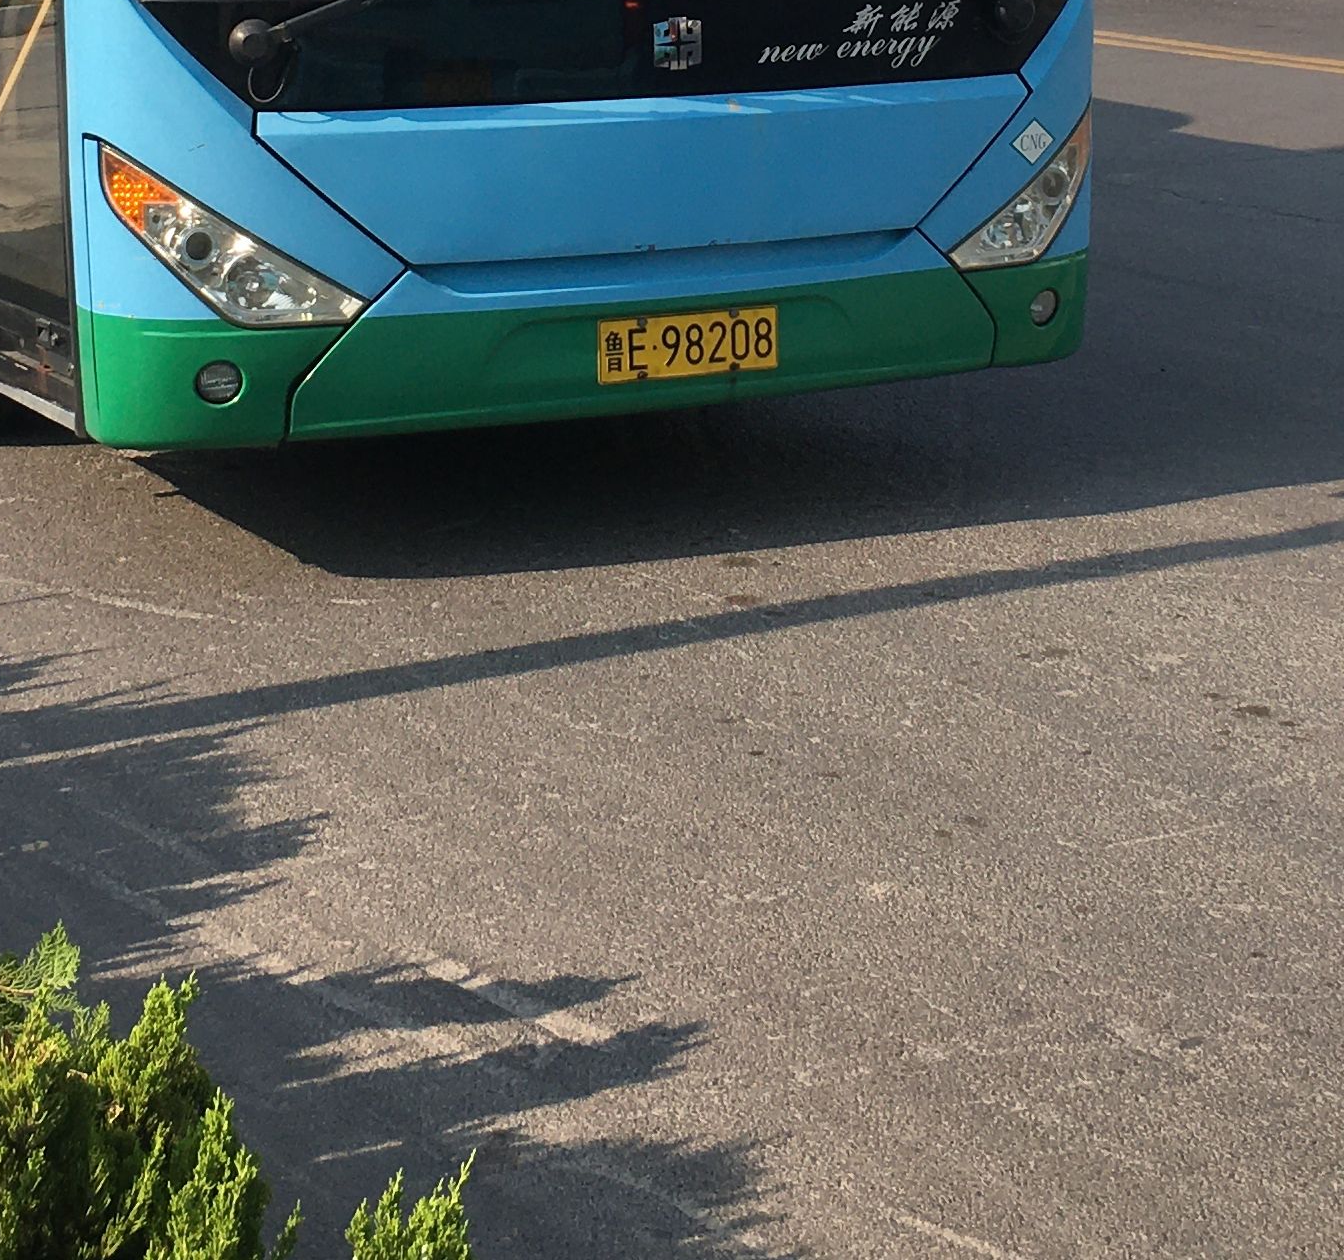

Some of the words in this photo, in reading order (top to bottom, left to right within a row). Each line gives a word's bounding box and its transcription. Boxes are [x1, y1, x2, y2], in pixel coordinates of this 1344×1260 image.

[842, 0, 961, 38] 新能源
[758, 42, 829, 64] new
[836, 34, 941, 68] energy
[1020, 133, 1047, 152] CNG
